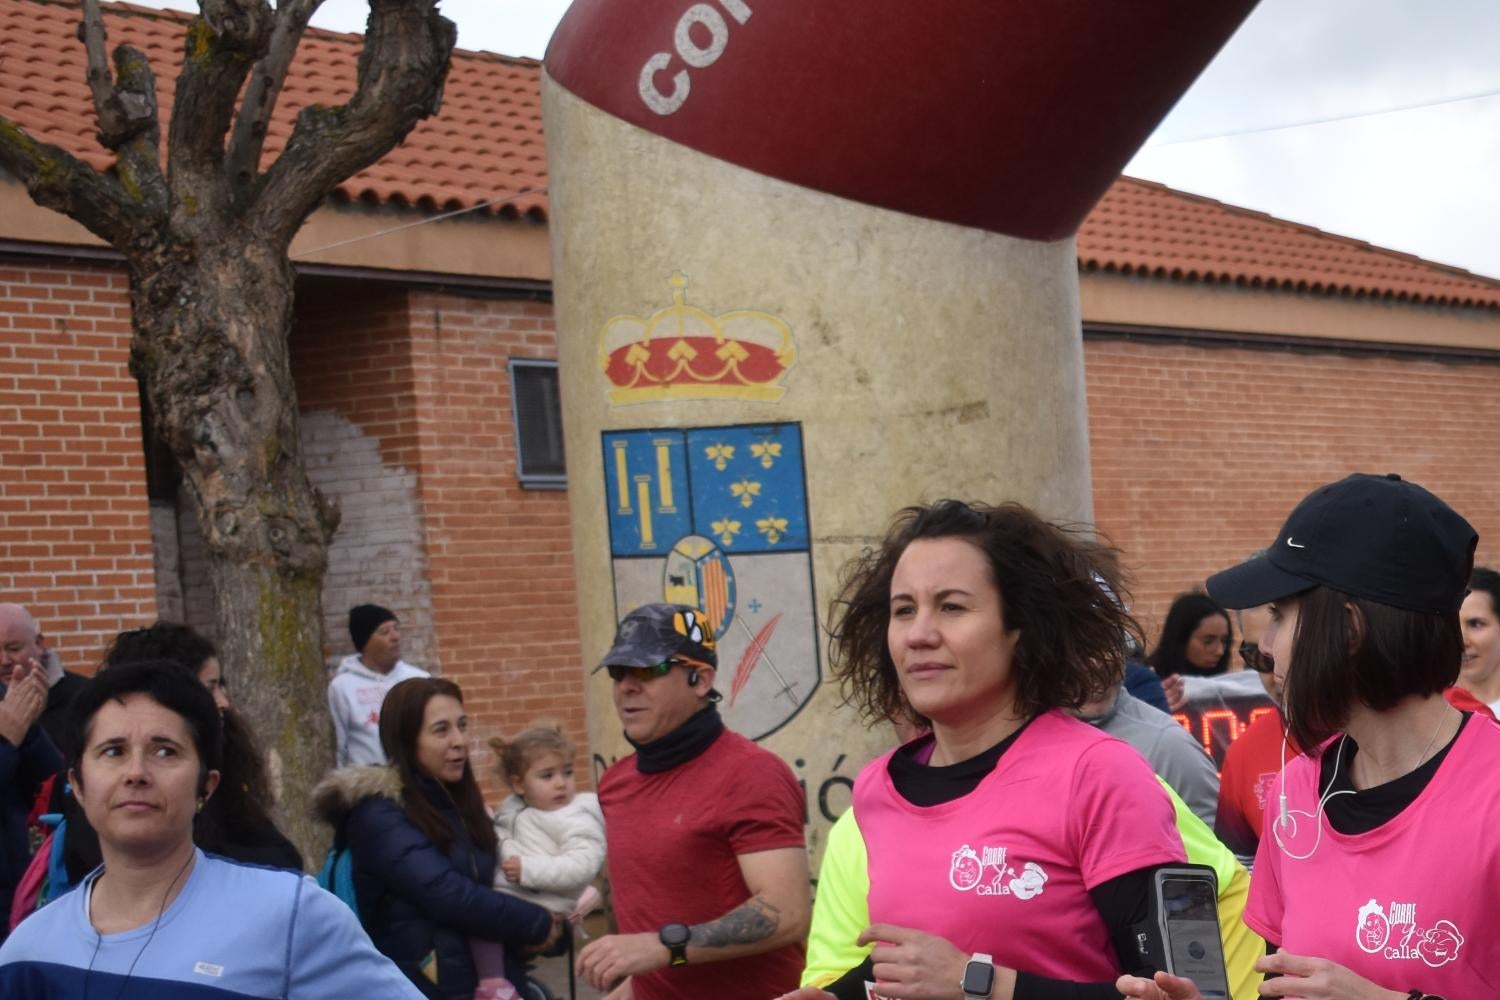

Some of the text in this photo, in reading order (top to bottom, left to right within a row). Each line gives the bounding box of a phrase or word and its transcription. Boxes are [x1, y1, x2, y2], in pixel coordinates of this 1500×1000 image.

[976, 882, 1011, 896] Calla
[1389, 901, 1417, 924] CORRE
[1384, 945, 1419, 959] Calla
